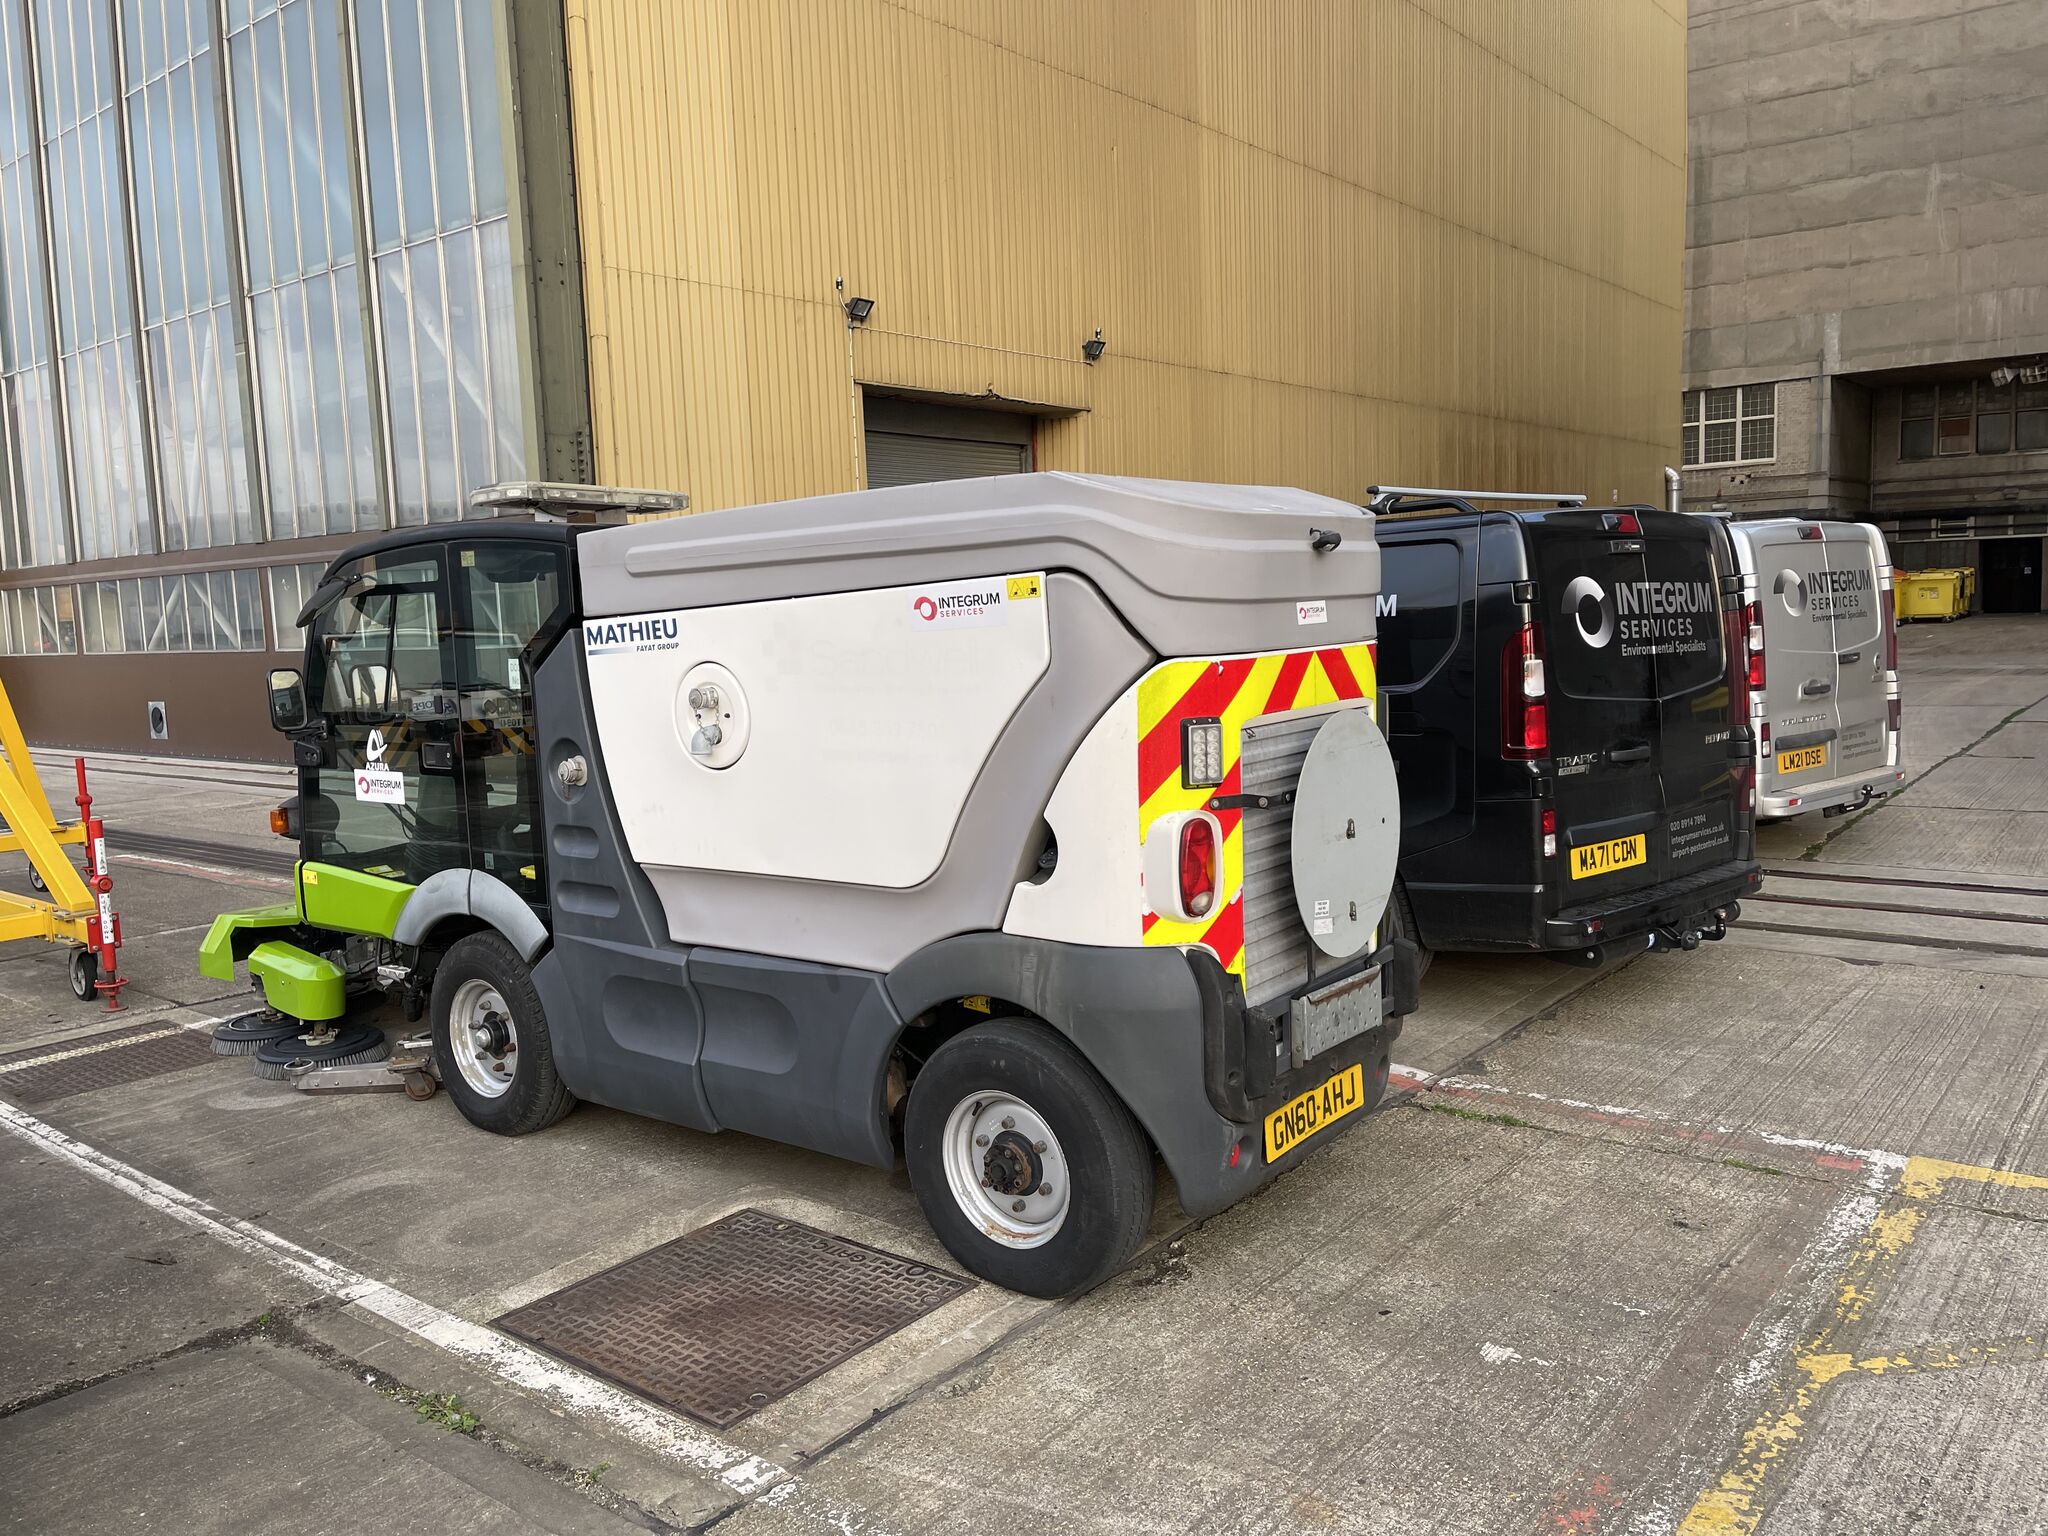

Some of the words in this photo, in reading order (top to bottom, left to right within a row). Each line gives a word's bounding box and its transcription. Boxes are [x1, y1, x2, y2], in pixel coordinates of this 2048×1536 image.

[1808, 570, 1871, 594] INTEGRUM
[938, 592, 1000, 609] INTEGRUM
[1615, 582, 1713, 615] INTEGRUM
[1811, 595, 1859, 611] SERVICES
[939, 606, 984, 618] SERVICES
[586, 617, 678, 646] MATHIEU
[1620, 618, 1693, 640] SERVICES
[636, 644, 656, 653] FAYAT
[657, 642, 680, 652] GROUP
[1621, 640, 1675, 657] Environmental
[1675, 640, 1706, 656] Specialists
[365, 761, 390, 772] AZURA
[1556, 752, 1598, 768] TRAFIC
[1805, 749, 1822, 767] DSE
[370, 778, 401, 790] INTEGRUM
[1580, 845, 1609, 872] MA71
[1613, 839, 1637, 864] CDN
[1323, 1072, 1356, 1120] AHJ
[812, 1241, 866, 1263] GATIC
